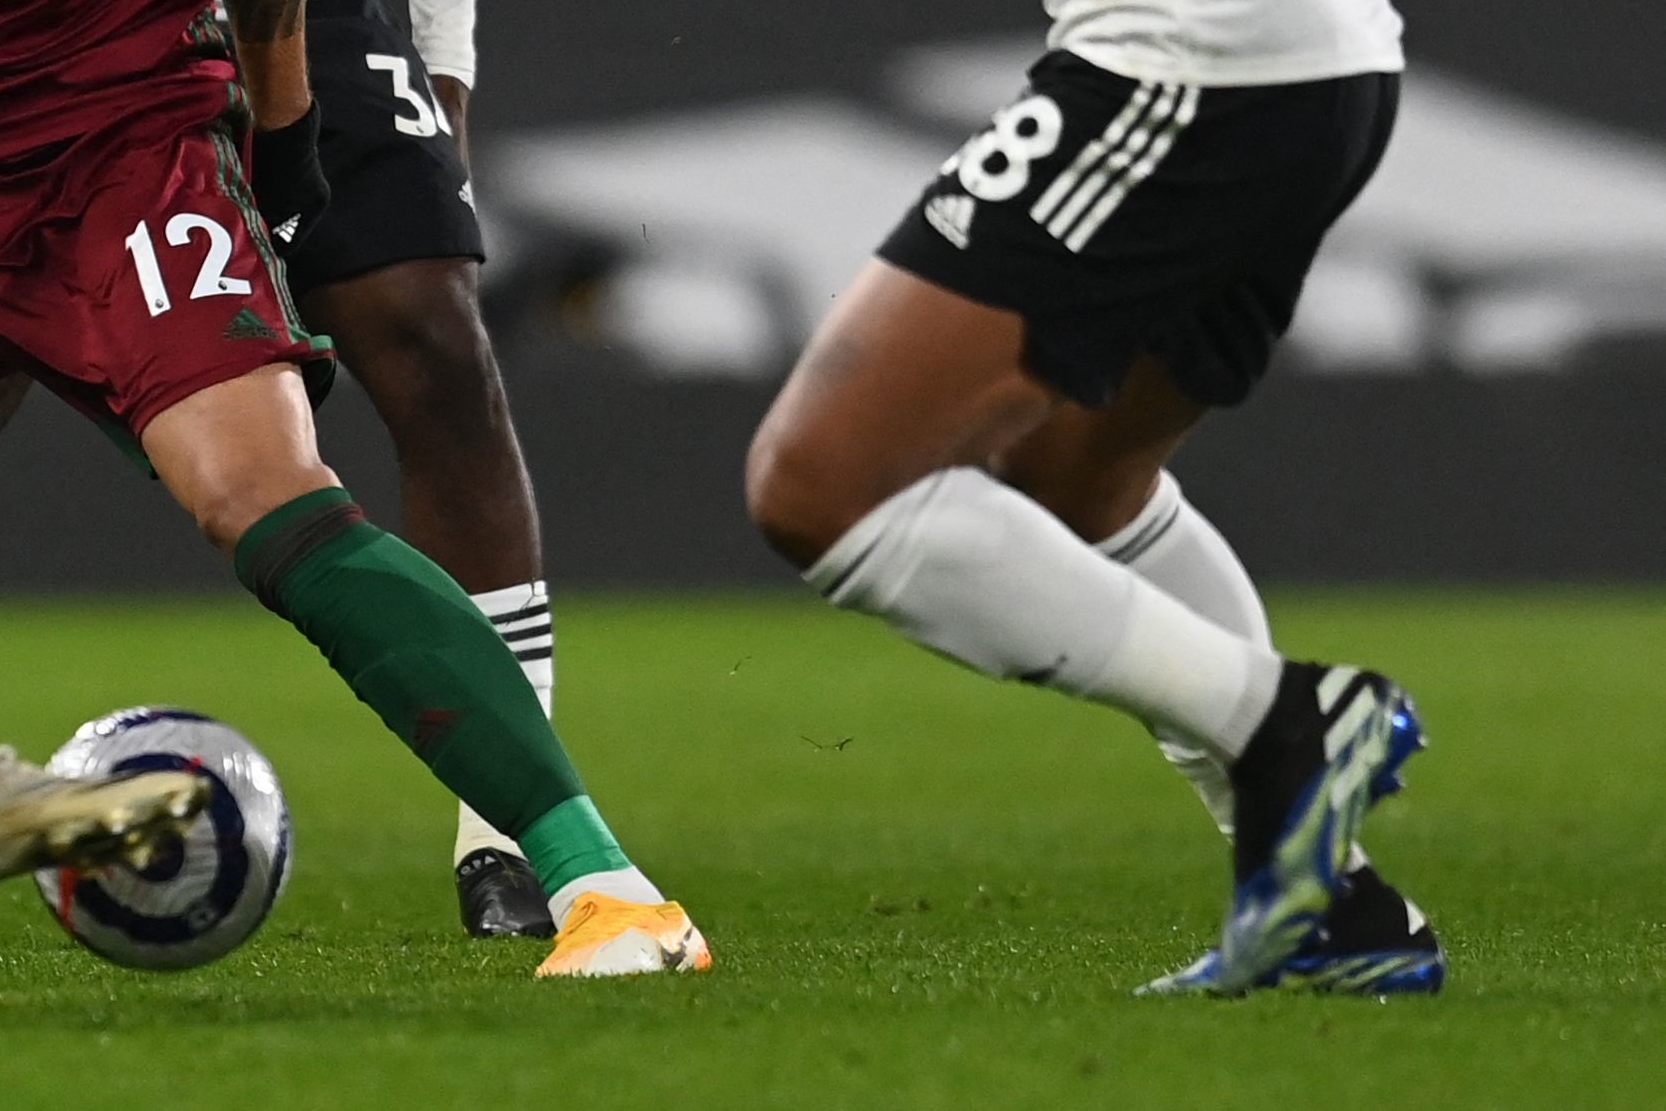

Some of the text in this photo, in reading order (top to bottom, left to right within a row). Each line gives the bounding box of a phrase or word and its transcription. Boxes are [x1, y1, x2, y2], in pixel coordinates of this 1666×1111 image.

[365, 53, 452, 137] 3
[940, 94, 1063, 201] 8
[125, 213, 252, 317] 12
